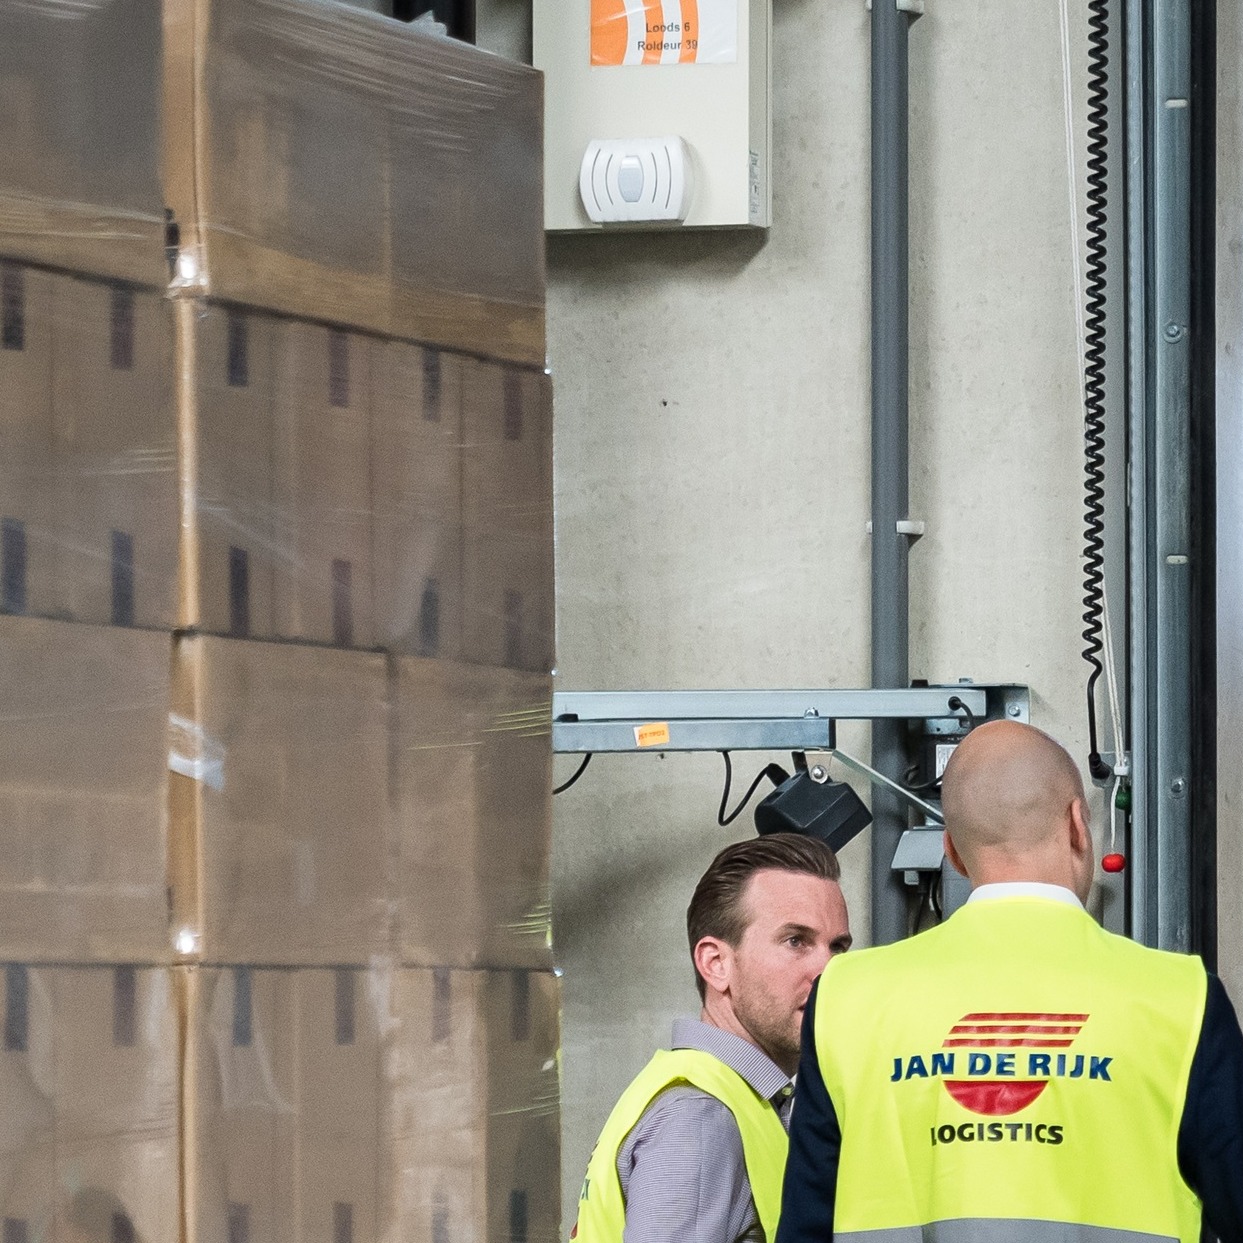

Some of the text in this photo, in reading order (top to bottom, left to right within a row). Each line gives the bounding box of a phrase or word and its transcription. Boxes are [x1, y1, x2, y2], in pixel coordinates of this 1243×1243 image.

[646, 22, 690, 32] Loods 6
[637, 41, 681, 50] Roldeur
[890, 1053, 1114, 1082] JAN DE RIJK
